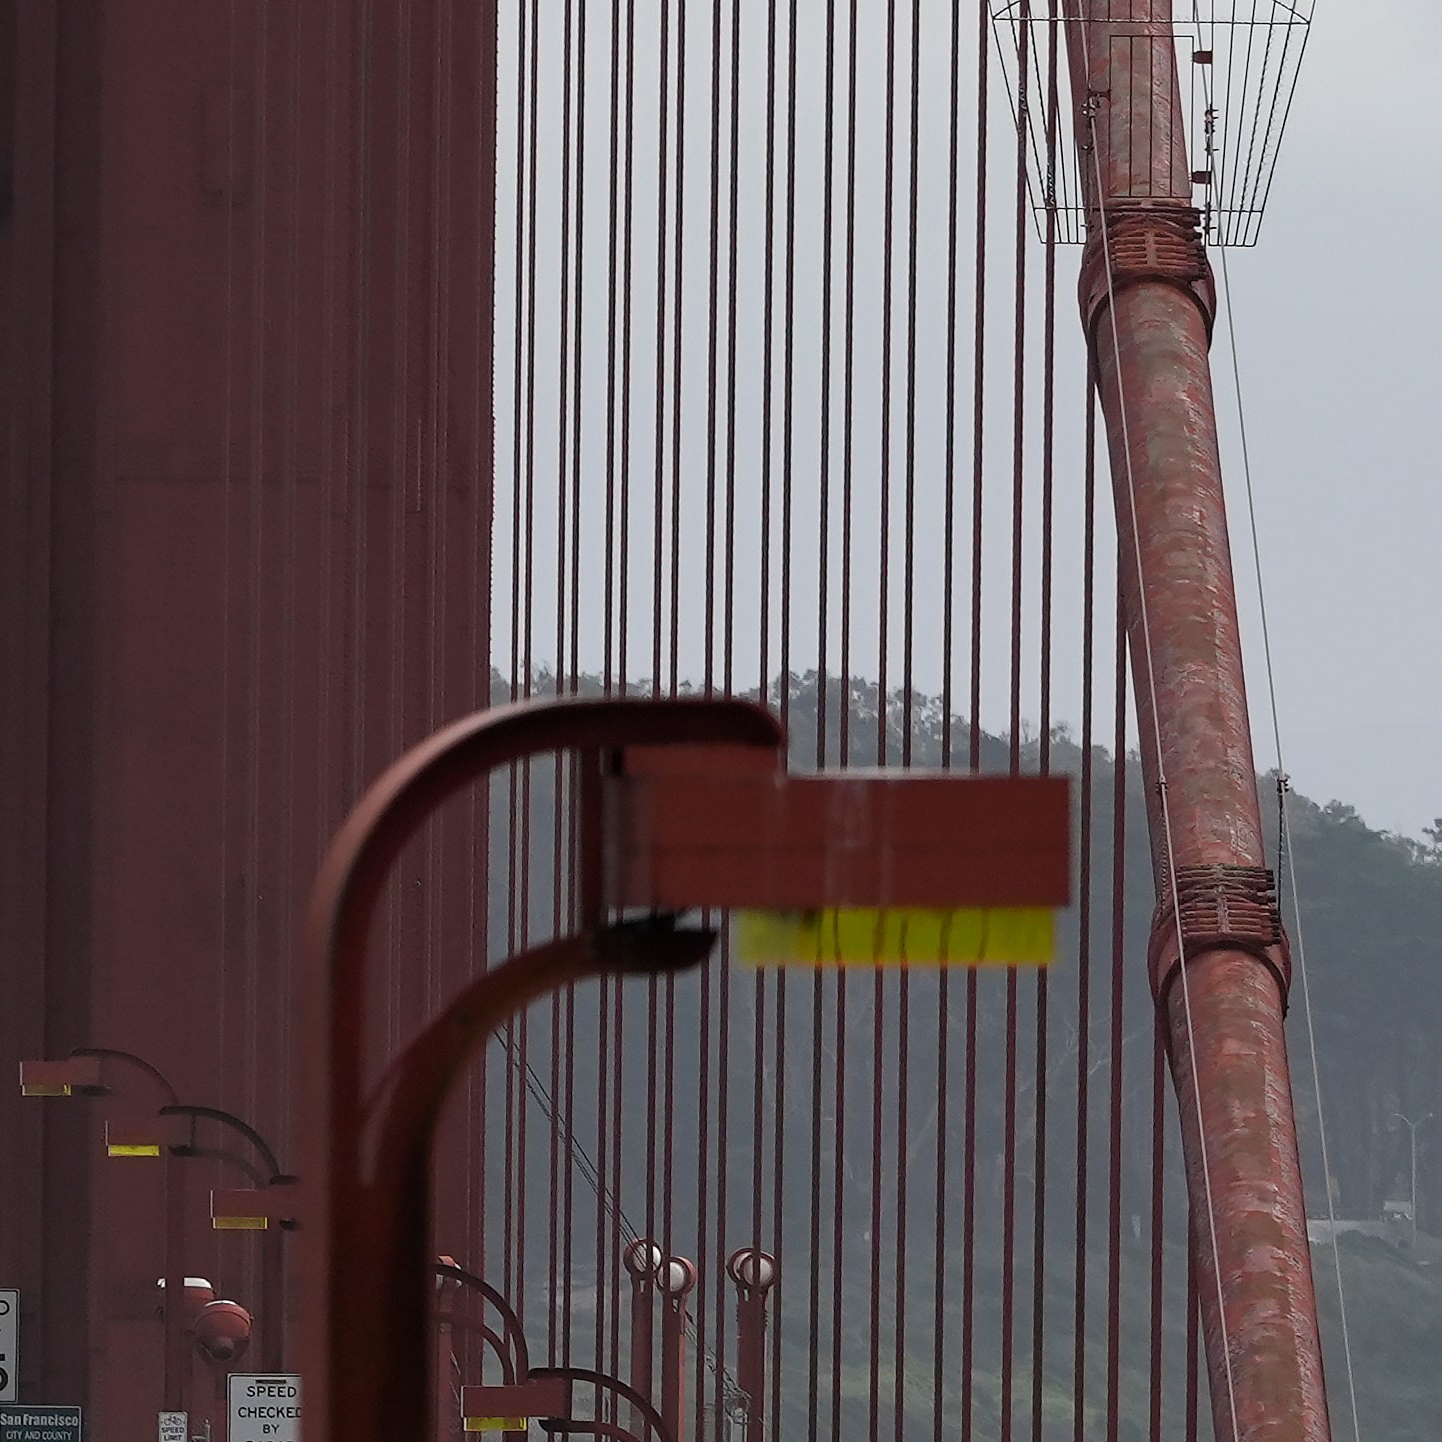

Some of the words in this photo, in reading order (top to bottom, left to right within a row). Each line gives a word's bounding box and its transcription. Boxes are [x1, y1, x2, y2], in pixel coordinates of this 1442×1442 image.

[246, 1386, 297, 1397] SPEED
[0, 1413, 23, 1426] San
[23, 1414, 78, 1426] Francisco
[262, 1424, 279, 1433] BY
[6, 1431, 22, 1440] CITY
[25, 1431, 40, 1440] AND
[42, 1431, 72, 1440] COUNTY
